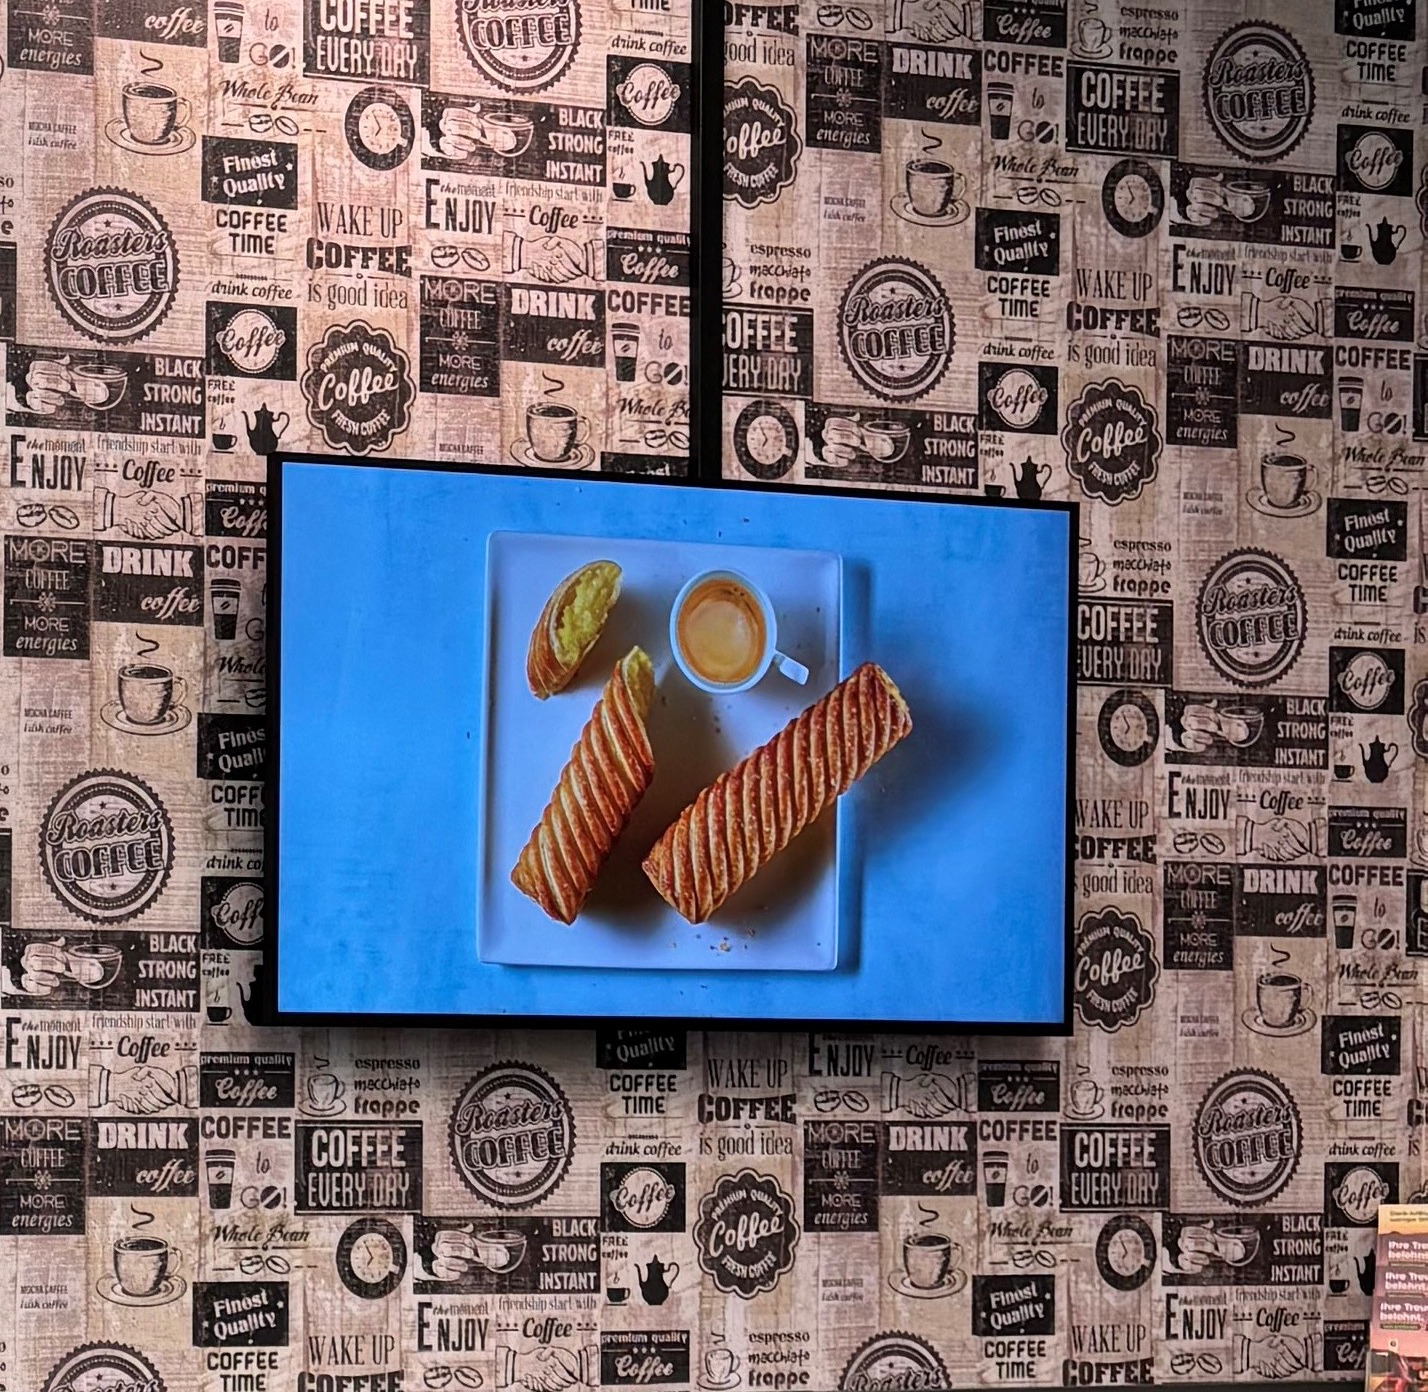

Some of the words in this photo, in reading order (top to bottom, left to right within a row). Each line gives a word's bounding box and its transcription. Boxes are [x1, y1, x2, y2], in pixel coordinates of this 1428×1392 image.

[611, 34, 646, 50] drink
[649, 41, 687, 56] coffee
[20, 48, 82, 69] energies
[892, 47, 972, 80] DRINK
[983, 49, 1064, 78] COFFEE
[1209, 56, 1306, 86] Roasters
[620, 81, 679, 110] Coffee
[1215, 86, 1309, 123] COFFEE
[559, 108, 603, 128] BLACK
[549, 132, 603, 152] STRONG
[223, 149, 278, 174] Finest
[546, 161, 603, 182] INSTANT
[223, 171, 285, 198] Quality
[425, 178, 495, 234] ENJOY
[216, 209, 288, 232] COFFEE
[317, 201, 373, 236] WAKE
[381, 208, 403, 239] UP
[529, 205, 579, 234] Coffee
[51, 226, 168, 262] Roasters
[229, 233, 275, 254] TIME
[1280, 225, 1332, 244] INSTANT
[306, 237, 412, 278] COFFEE
[60, 260, 169, 300] COFFEE
[211, 279, 248, 296] drink
[252, 283, 292, 300] coffee
[424, 279, 495, 304] MORE
[307, 279, 322, 302] is
[328, 281, 364, 309] good
[374, 282, 408, 309] idea
[511, 288, 596, 320] DRINK
[440, 310, 481, 330] COFFEE
[844, 296, 944, 324] Roasters
[547, 329, 603, 361] coffee
[850, 323, 946, 361] COFFEE
[155, 359, 202, 379] BLACK
[431, 372, 488, 391] energies
[145, 383, 202, 405] STRONG
[319, 367, 399, 411] Coffee
[141, 412, 202, 434] INSTANT
[10, 434, 86, 491] ENJOY
[123, 459, 174, 488] Coffee
[9, 539, 86, 564] MORE
[102, 546, 194, 577] DRINK
[26, 570, 70, 590] COFFEE
[1338, 564, 1398, 582] COFFEE
[140, 586, 201, 620] coffee
[1349, 584, 1387, 602] TIME
[24, 617, 69, 632] MORE
[16, 636, 78, 655] energies
[1277, 722, 1326, 739] STRONG
[1260, 790, 1303, 815] Coffee
[47, 808, 163, 845] Roasters
[54, 837, 164, 882] COFFEE
[1244, 869, 1319, 894] DRINK
[1328, 865, 1405, 887] COFFEE
[149, 935, 196, 953] BLACK
[138, 960, 196, 979] STRONG
[1076, 949, 1145, 992] Coffee
[135, 990, 196, 1008] INSTANT
[117, 1035, 170, 1063] Coffee
[201, 1055, 249, 1065] premium
[255, 1056, 292, 1066] quality
[215, 1077, 278, 1106] Coffee
[201, 1116, 292, 1140] COFFEE
[455, 1099, 566, 1134] Roasters
[98, 1123, 189, 1149] DRINK
[889, 1127, 968, 1151] DRINK
[980, 1119, 1057, 1141] COFFEE
[312, 1129, 406, 1168] COFFEE
[462, 1126, 566, 1171] COFFEE
[136, 1159, 195, 1191] coffee
[709, 1213, 784, 1257] Coffee
[542, 1244, 597, 1261] STRONG
[1271, 1265, 1320, 1283] INSTANT
[213, 1290, 268, 1317] Finest
[214, 1312, 276, 1339] Quality
[523, 1316, 572, 1343] Coffee
[1072, 1325, 1120, 1353] WAKE
[1126, 1325, 1146, 1352] UP
